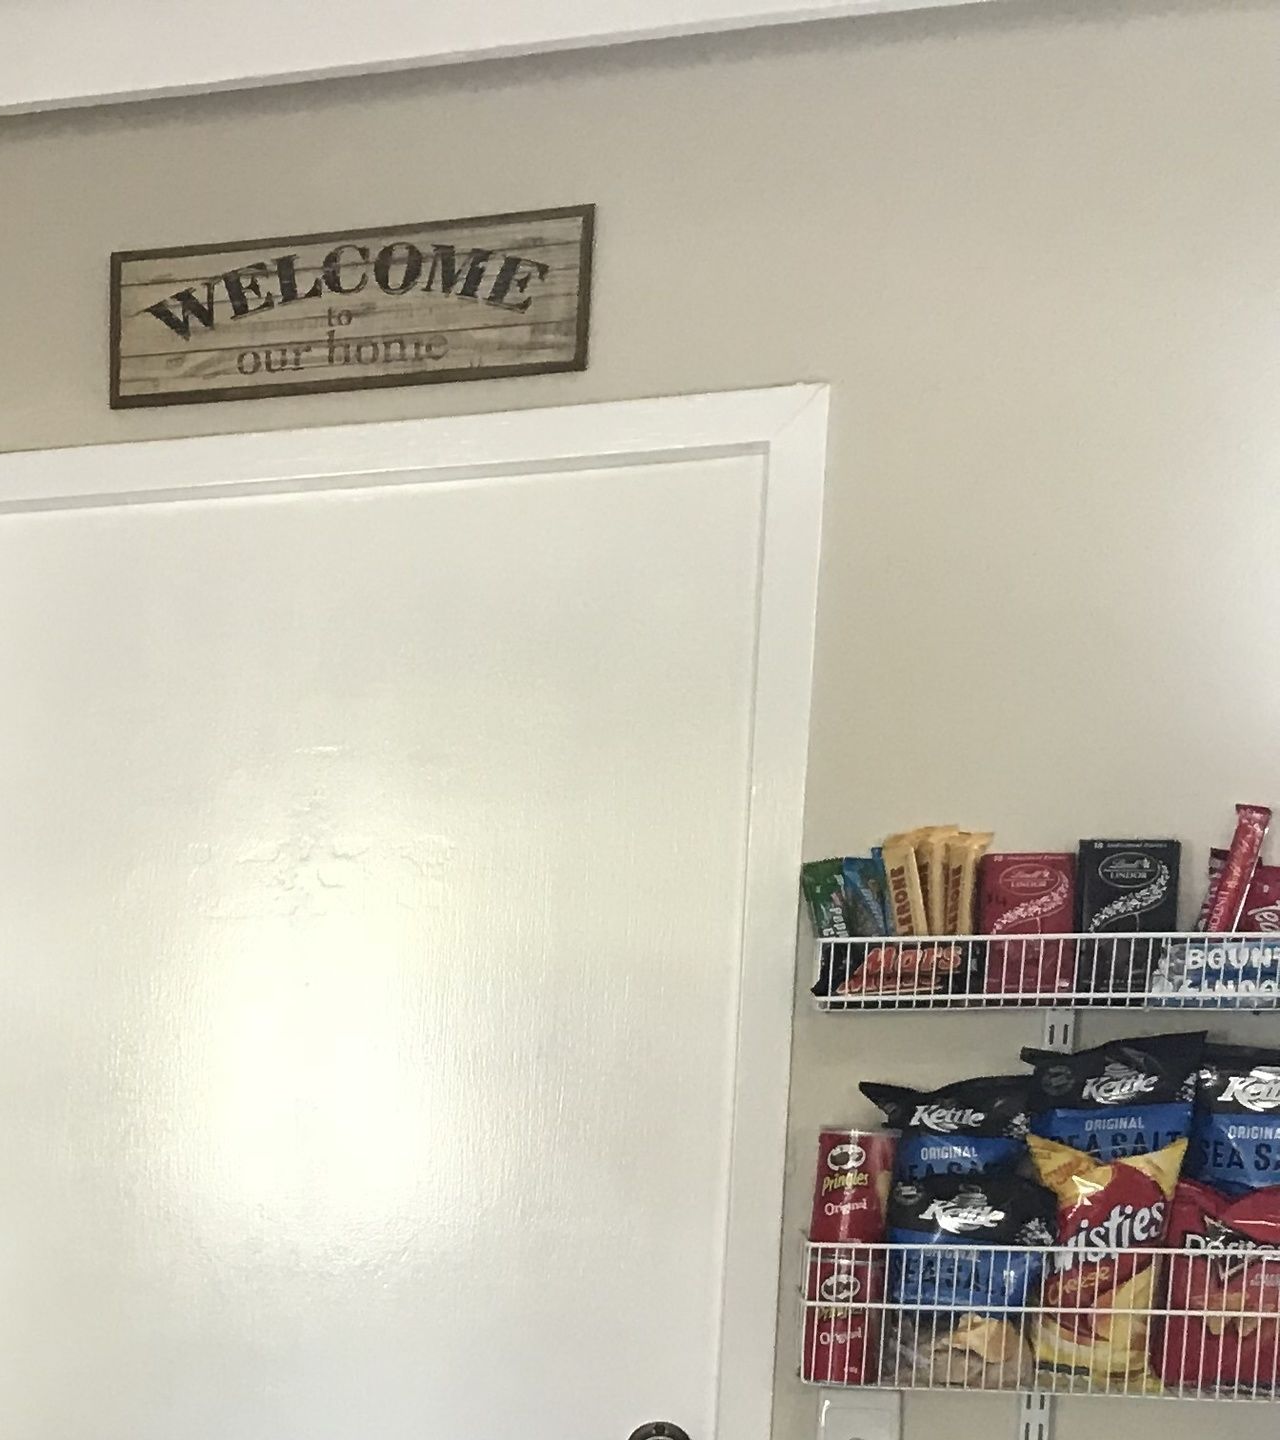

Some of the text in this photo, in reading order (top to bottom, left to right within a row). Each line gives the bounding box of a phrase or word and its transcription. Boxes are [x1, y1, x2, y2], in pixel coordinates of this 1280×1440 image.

[144, 241, 549, 341] WELCOME
[327, 305, 352, 327] to
[236, 329, 450, 375] our home
[1011, 880, 1047, 888] LINDOR
[1110, 871, 1147, 879] LINDOR
[853, 946, 963, 976] Mars
[1082, 1073, 1159, 1105] Kettle
[909, 1105, 985, 1132] Kettle
[1085, 1117, 1144, 1131] ORIGINAL
[921, 1146, 978, 1160] ORIGINAL
[1200, 1141, 1244, 1169] SEA
[822, 1172, 869, 1196] Pringles
[824, 1198, 868, 1216] Original
[919, 1199, 1005, 1234] Kettle
